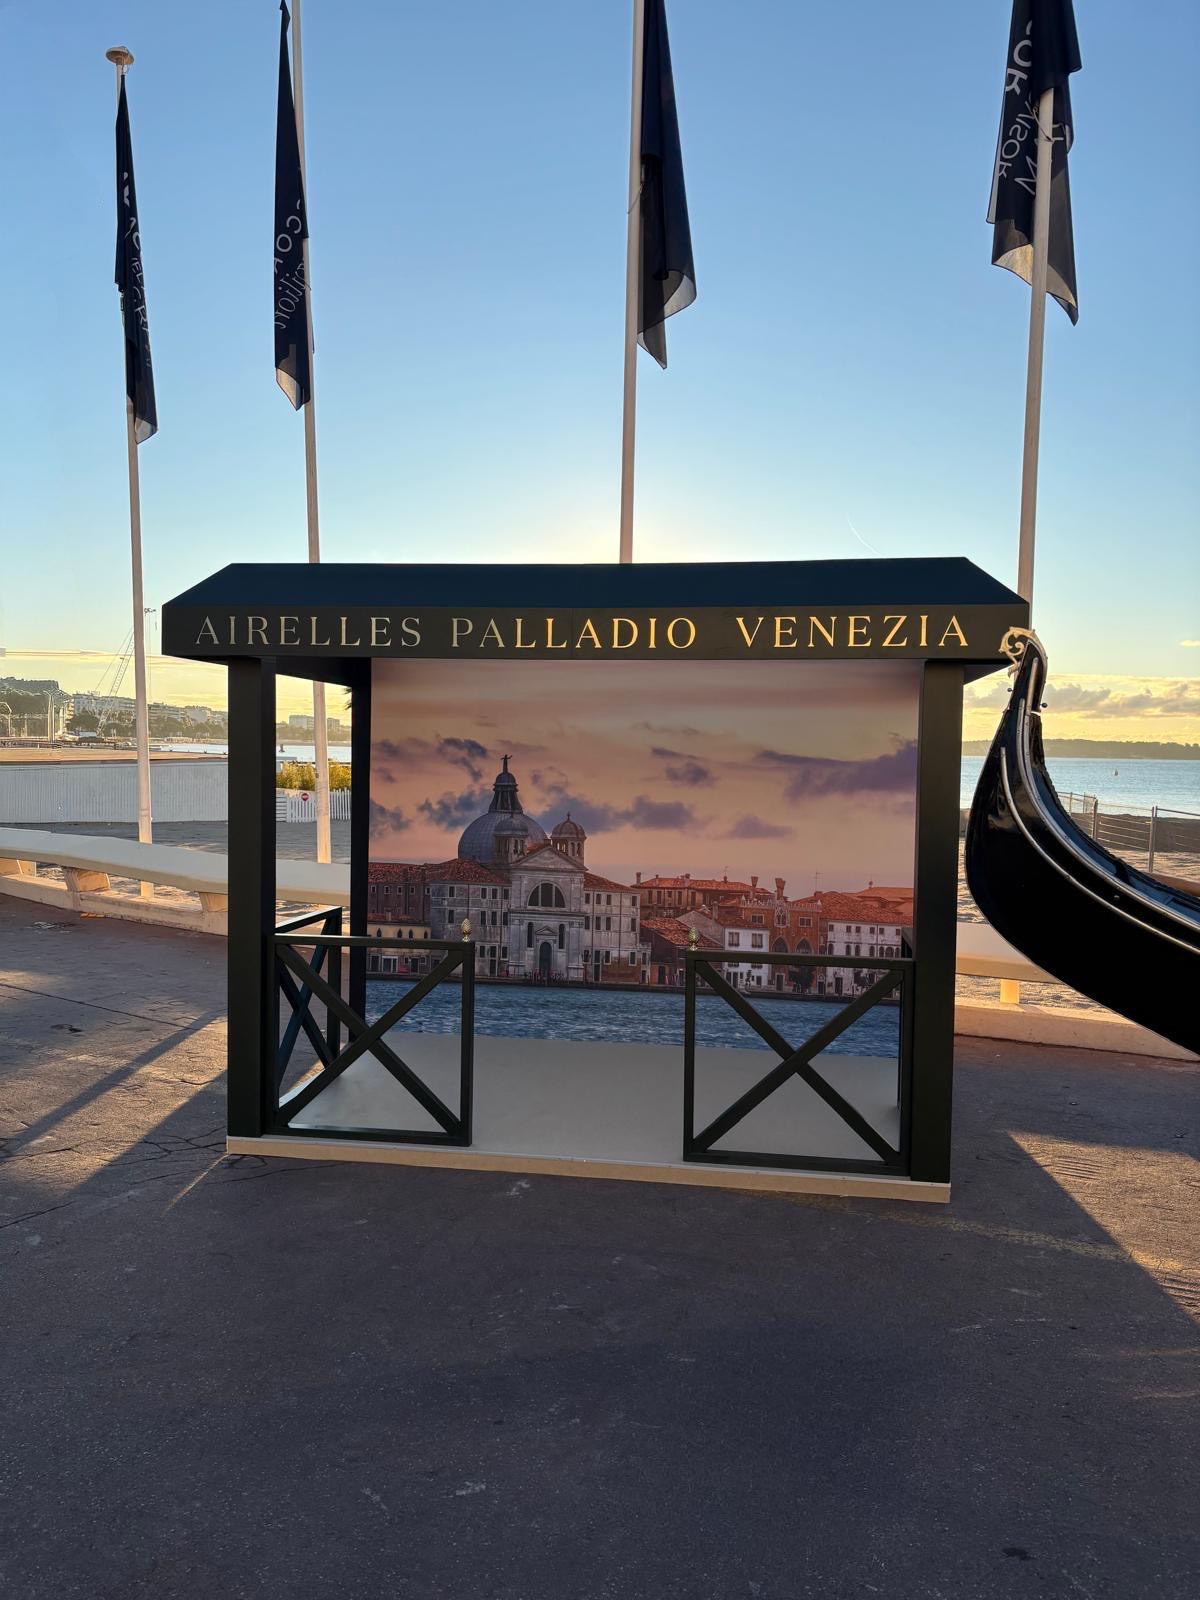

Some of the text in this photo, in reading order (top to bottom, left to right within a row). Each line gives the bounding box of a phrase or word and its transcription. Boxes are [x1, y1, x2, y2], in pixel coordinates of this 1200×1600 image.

[195, 614, 969, 649] AIRELLES PALLADIO VENEZIA
